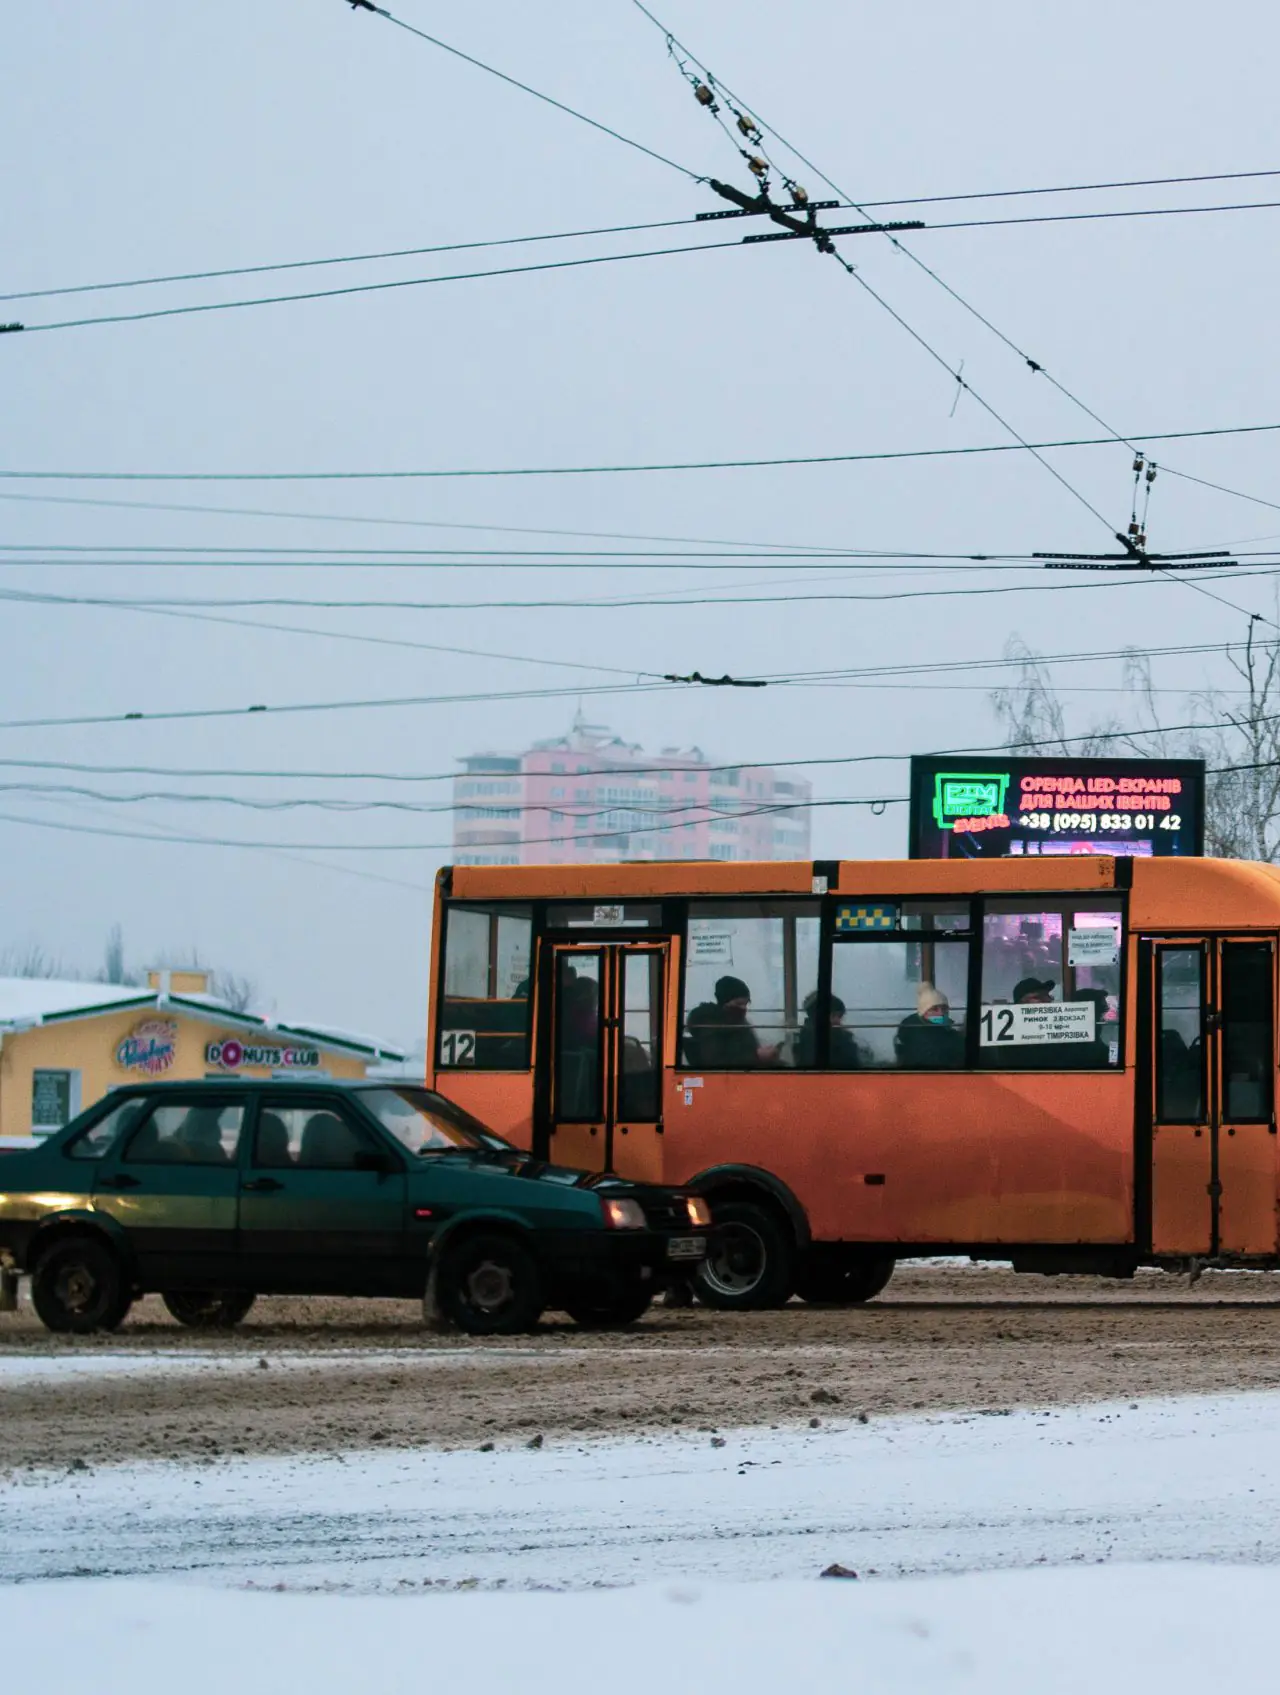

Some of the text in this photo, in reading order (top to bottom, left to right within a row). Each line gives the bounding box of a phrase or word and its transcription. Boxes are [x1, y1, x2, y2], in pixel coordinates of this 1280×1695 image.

[1020, 777, 1085, 793] ОРЕНДА
[1019, 794, 1053, 810] ДЛЯ
[1055, 795, 1115, 809] ВАШИХ
[953, 814, 1010, 833] EVENTS
[1019, 813, 1182, 832] +38 (095) 833 01 42
[981, 1009, 1015, 1042] 12
[209, 1040, 321, 1068] DONUTS CLUB
[443, 1033, 475, 1065] 12
